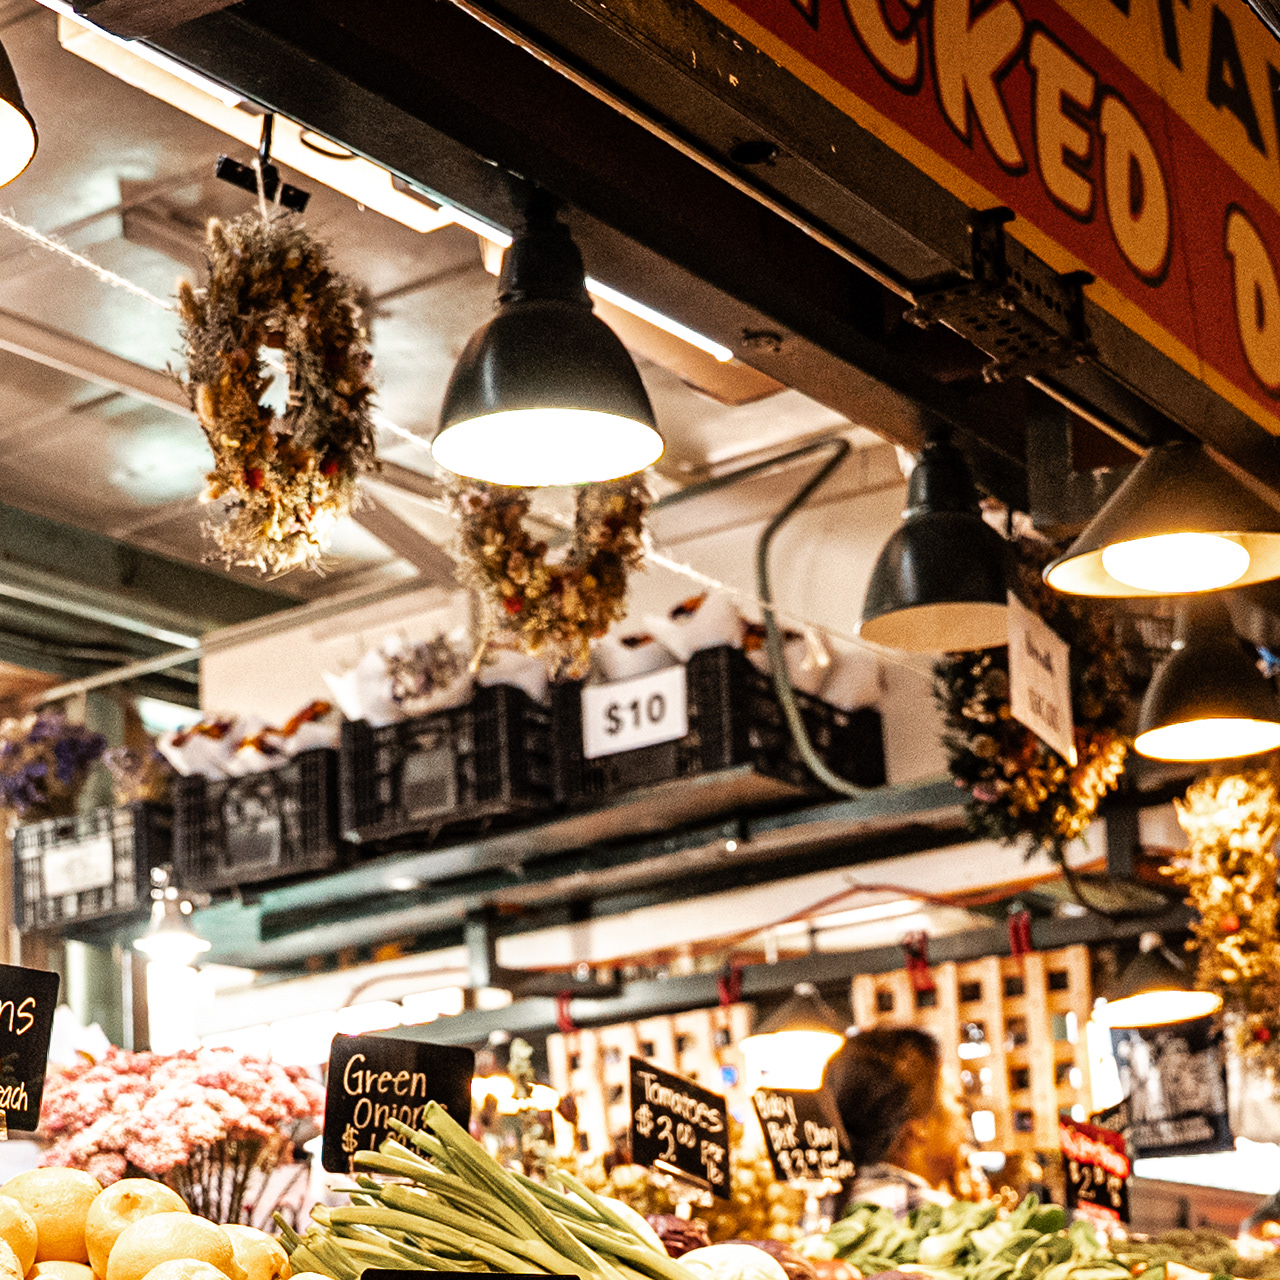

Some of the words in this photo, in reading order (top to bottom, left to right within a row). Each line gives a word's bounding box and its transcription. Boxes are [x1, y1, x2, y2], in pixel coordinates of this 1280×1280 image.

[790, 0, 1176, 288] CKED
[605, 693, 666, 735] $10
[343, 1053, 426, 1097] Green
[353, 1097, 448, 1130] Onion
[637, 1070, 724, 1133] Tomatoes
